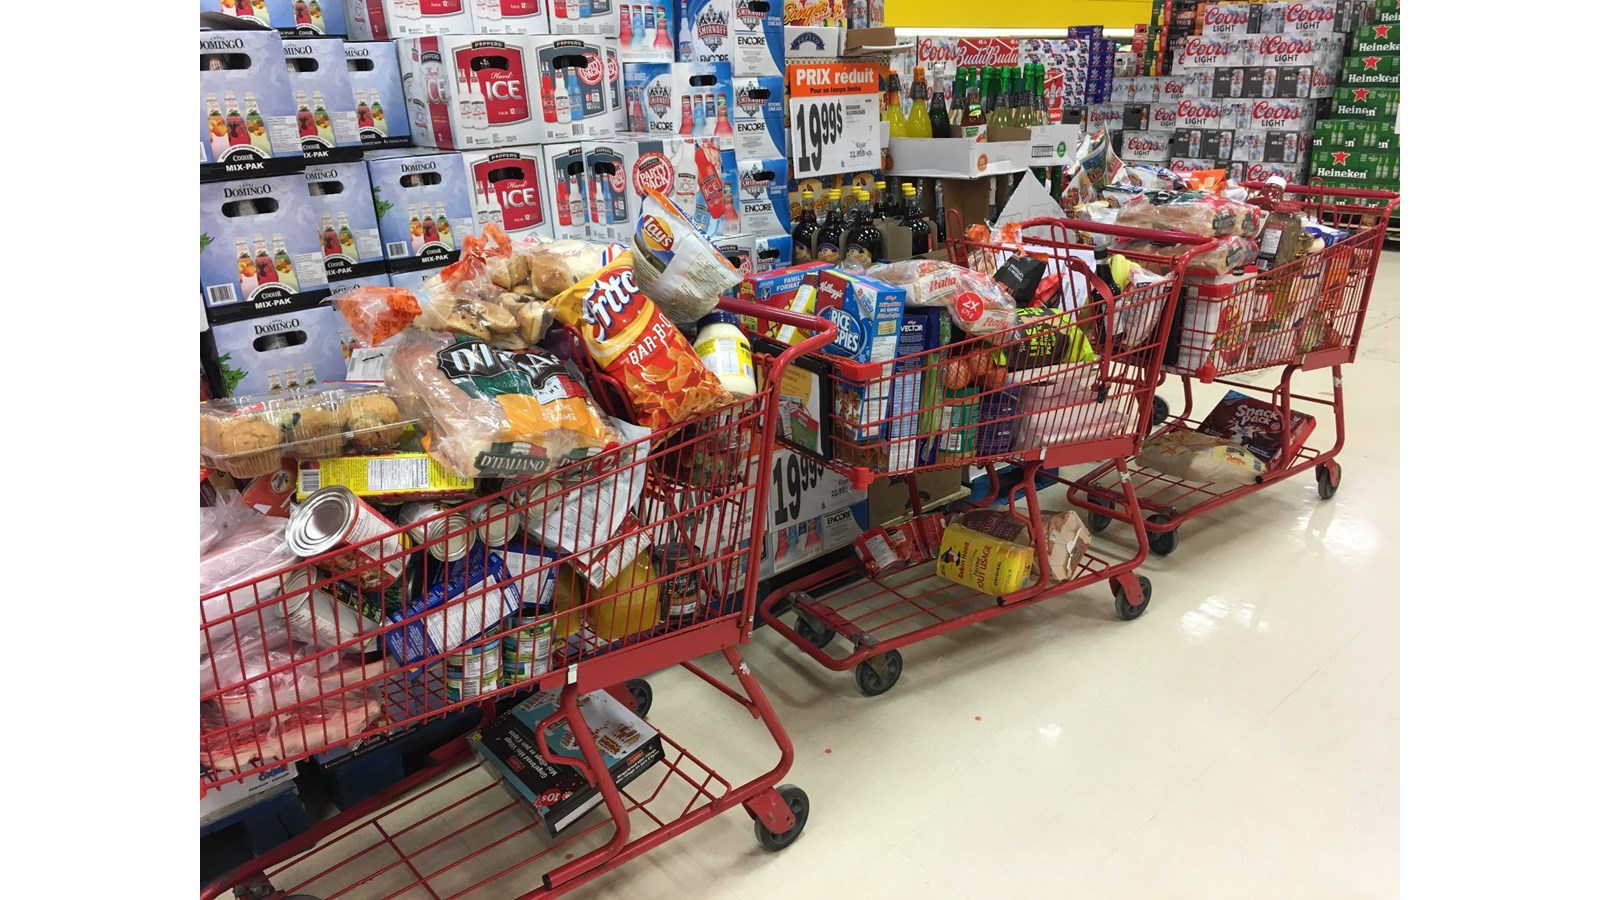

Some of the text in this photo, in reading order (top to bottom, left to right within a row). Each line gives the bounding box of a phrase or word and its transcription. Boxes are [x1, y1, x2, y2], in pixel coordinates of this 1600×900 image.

[1205, 7, 1247, 25] Coors
[1286, 4, 1334, 22] Coors
[698, 25, 727, 37] SMIRNOFF
[1295, 22, 1320, 30] LIGHT
[737, 36, 765, 46] ENCORE
[1186, 38, 1228, 56] Coors
[1263, 36, 1312, 55] Coors
[1359, 42, 1400, 51] Heineke
[283, 45, 312, 55] MINGO
[344, 48, 369, 57] MINGO
[919, 38, 957, 61] Coors
[1275, 54, 1299, 62] LIGHT
[927, 62, 946, 70] LIT
[796, 66, 874, 86] PRIX réduit
[1348, 73, 1399, 84] Heineken
[485, 80, 523, 101] ICE
[1165, 80, 1184, 94] Coo
[1155, 107, 1176, 121] Coo
[1177, 100, 1219, 118] Coors
[1253, 100, 1299, 119] Coors
[650, 121, 673, 131] ENCORE
[738, 123, 765, 132] ENCORE
[1185, 117, 1207, 125] LIGHT
[1128, 137, 1159, 150] Coors
[303, 150, 328, 159] IX-PAK
[401, 161, 436, 173] DOMINGO
[640, 163, 667, 183] PARTY
[1317, 167, 1367, 179] Heineken
[305, 169, 338, 180] OMINGO
[223, 184, 272, 198] DOMINGO
[507, 181, 527, 189] Hard
[704, 182, 720, 199] ICE
[502, 187, 535, 210] ICE
[745, 203, 772, 213] ENCORE
[694, 213, 708, 222] CE
[784, 274, 805, 284] FAMILY
[928, 275, 957, 293] Italia
[776, 282, 800, 292] FORMAT
[819, 280, 844, 300] Kellogg's
[582, 270, 640, 343] Frito
[253, 318, 300, 336] DOMINGO
[830, 309, 851, 332] RICE
[901, 324, 923, 333] VECTOR
[832, 329, 860, 353] SPIES
[1235, 404, 1279, 420] Snack
[480, 454, 545, 472] D'ITALIANO
[827, 510, 851, 525] ENCORE
[962, 541, 970, 560] Hood
[980, 544, 992, 570] USAGE
